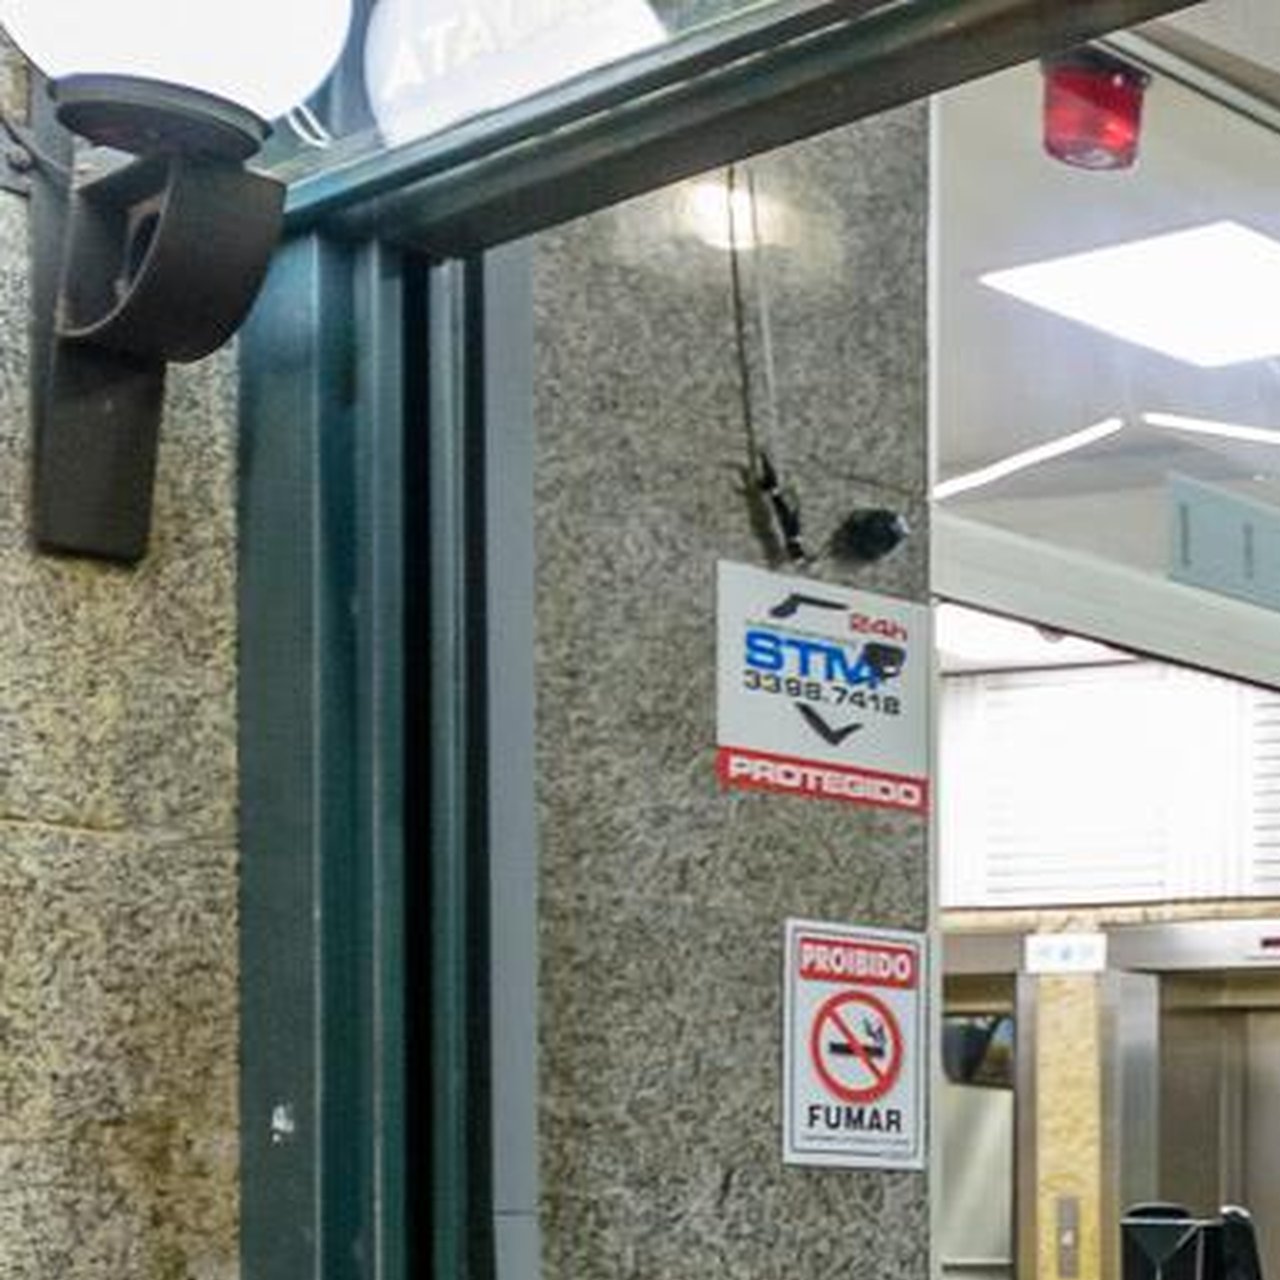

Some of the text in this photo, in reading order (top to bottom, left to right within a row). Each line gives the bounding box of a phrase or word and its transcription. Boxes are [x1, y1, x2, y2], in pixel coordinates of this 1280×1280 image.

[729, 758, 921, 805] PROTEGIDO
[802, 941, 912, 980] PROIBIDO
[808, 1104, 902, 1134] FUMAR
